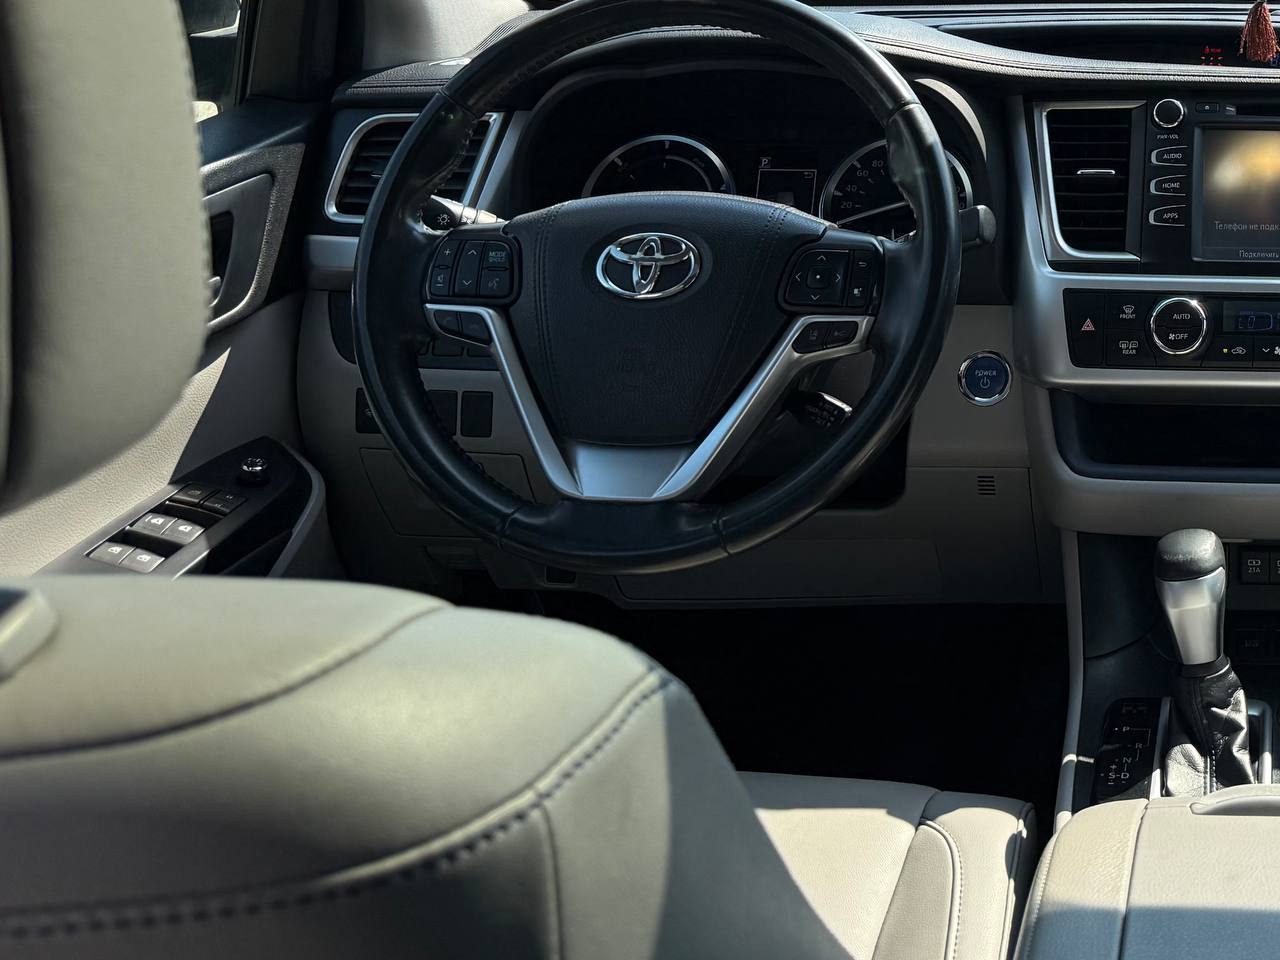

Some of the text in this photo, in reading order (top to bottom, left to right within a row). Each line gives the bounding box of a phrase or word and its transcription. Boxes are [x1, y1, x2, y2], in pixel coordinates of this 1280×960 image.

[1214, 221, 1248, 232] Телефон
[1249, 223, 1259, 231] не
[1239, 250, 1279, 259] Подключить
